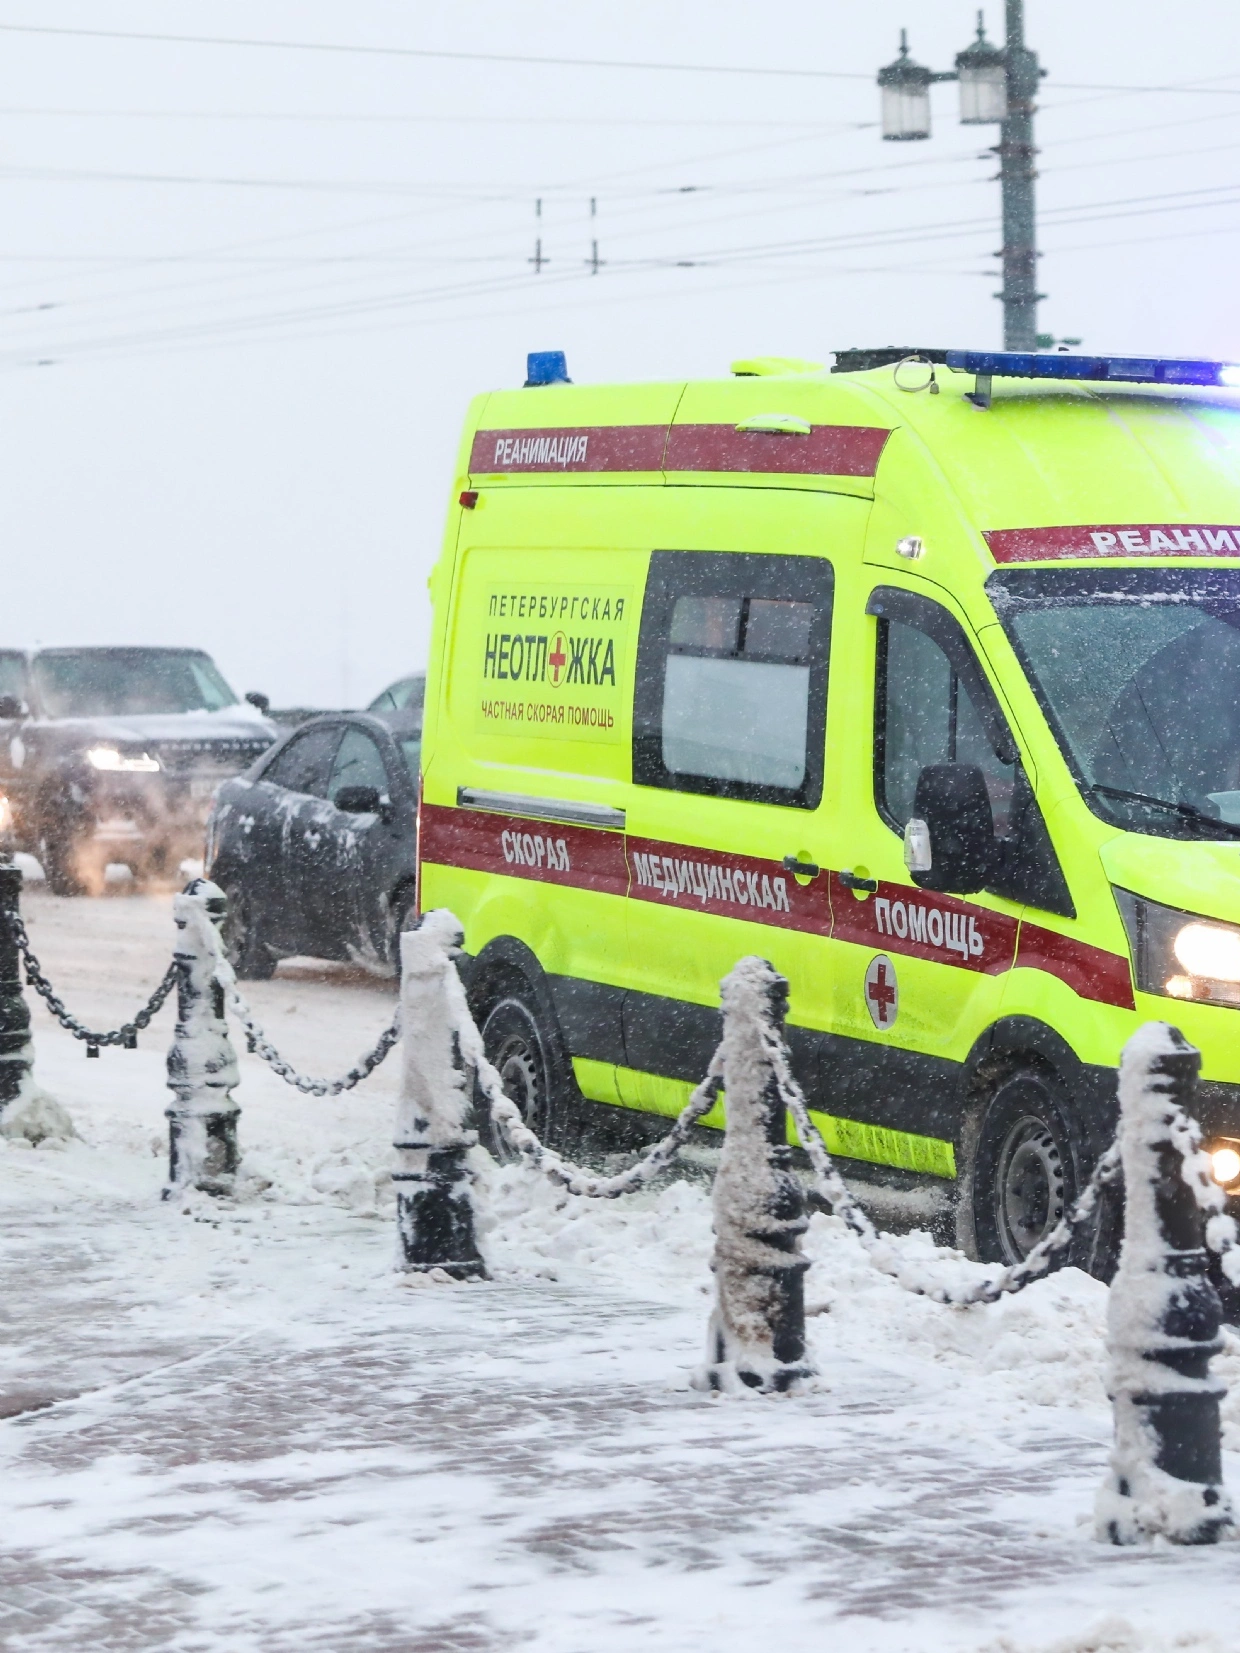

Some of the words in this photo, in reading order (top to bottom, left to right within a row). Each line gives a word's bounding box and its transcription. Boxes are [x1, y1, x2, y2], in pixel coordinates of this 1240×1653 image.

[494, 436, 589, 468] РЕАНИМАЦИЯ
[489, 594, 625, 621] ПЕТЕРБУРГСКАЯ
[481, 700, 524, 721] ЧАСТНАЯ
[526, 702, 565, 724] СКОРАЯ
[567, 705, 615, 731] ПОМОЩЬ
[501, 829, 570, 872] СКОРАЯ
[633, 852, 790, 913] МЕДИЦИНСКАЯ
[875, 896, 985, 961] ПОМОЩЬ
